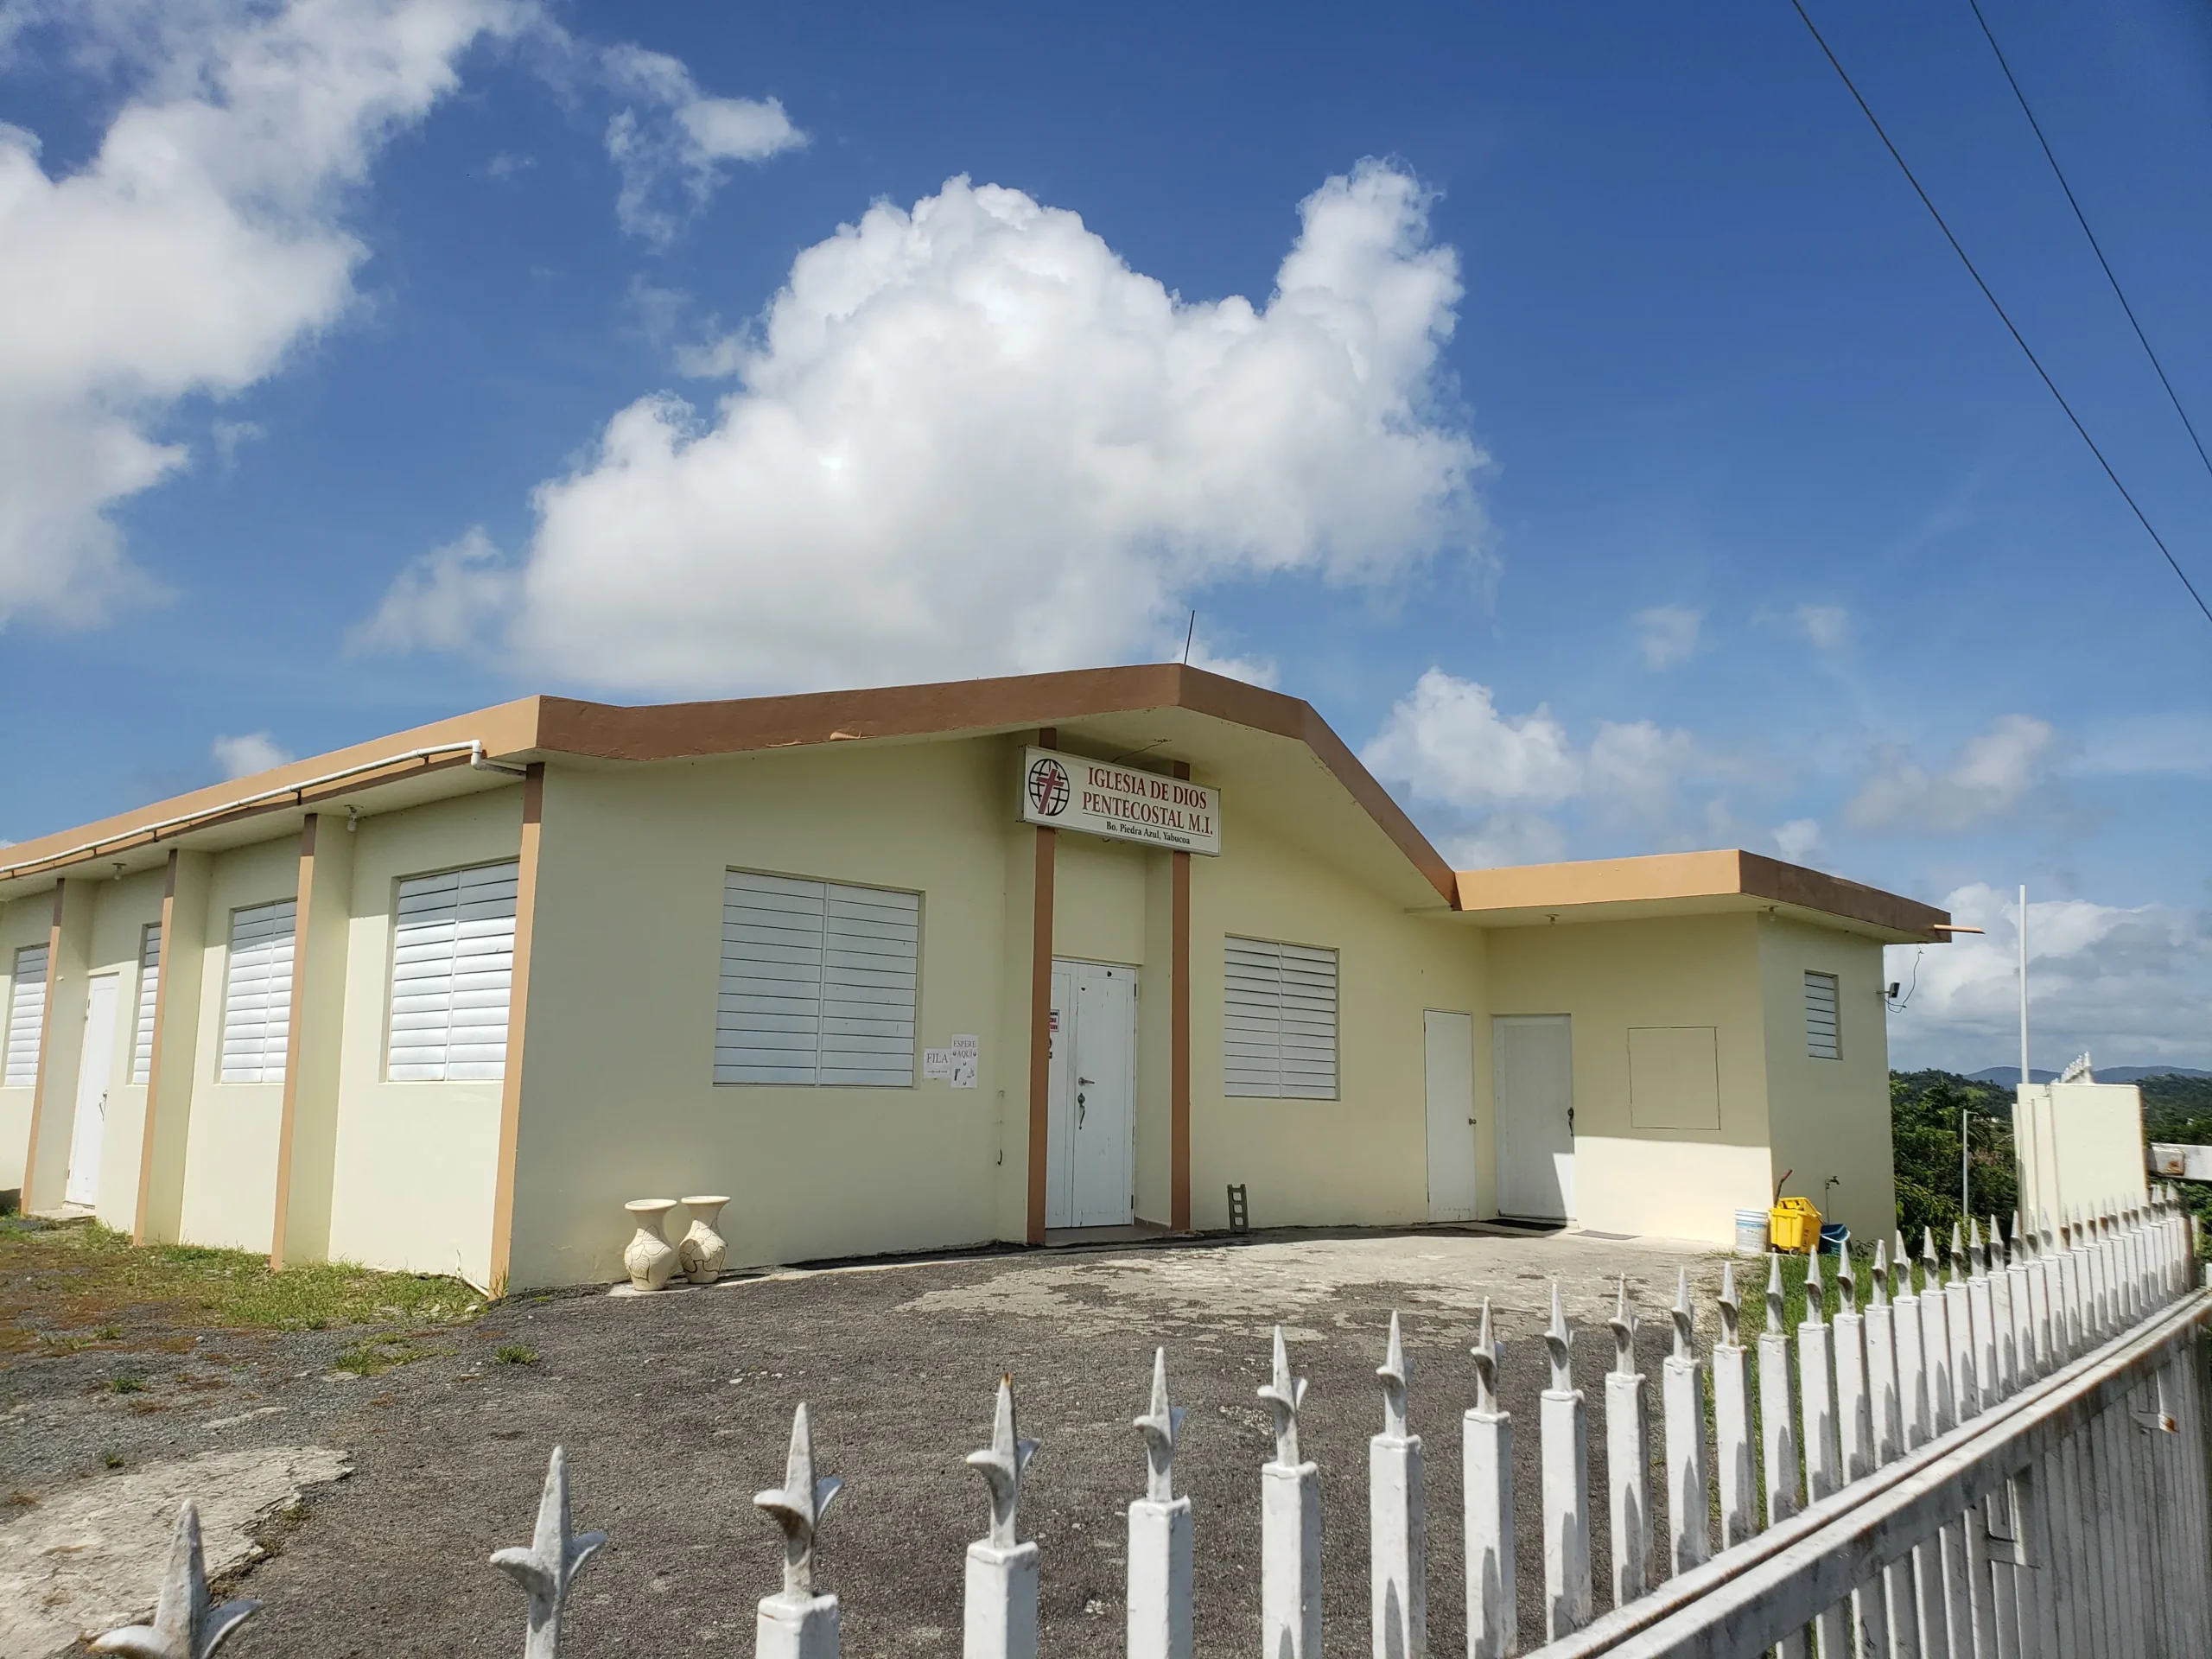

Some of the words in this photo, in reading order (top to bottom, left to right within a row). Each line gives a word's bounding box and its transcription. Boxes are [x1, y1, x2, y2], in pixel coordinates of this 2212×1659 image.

[1088, 766, 1146, 797] IGLESIA
[1150, 780, 1169, 802] DE
[1173, 785, 1207, 810] DIOS
[1082, 791, 1185, 830] PENTECOSTAL
[1188, 813, 1213, 836] M.I.
[1106, 821, 1118, 832] Bo.
[1120, 823, 1142, 836] Piedra
[1143, 828, 1161, 842] Azul,
[1163, 832, 1191, 845] Yabucoa
[926, 1052, 949, 1064] FILA
